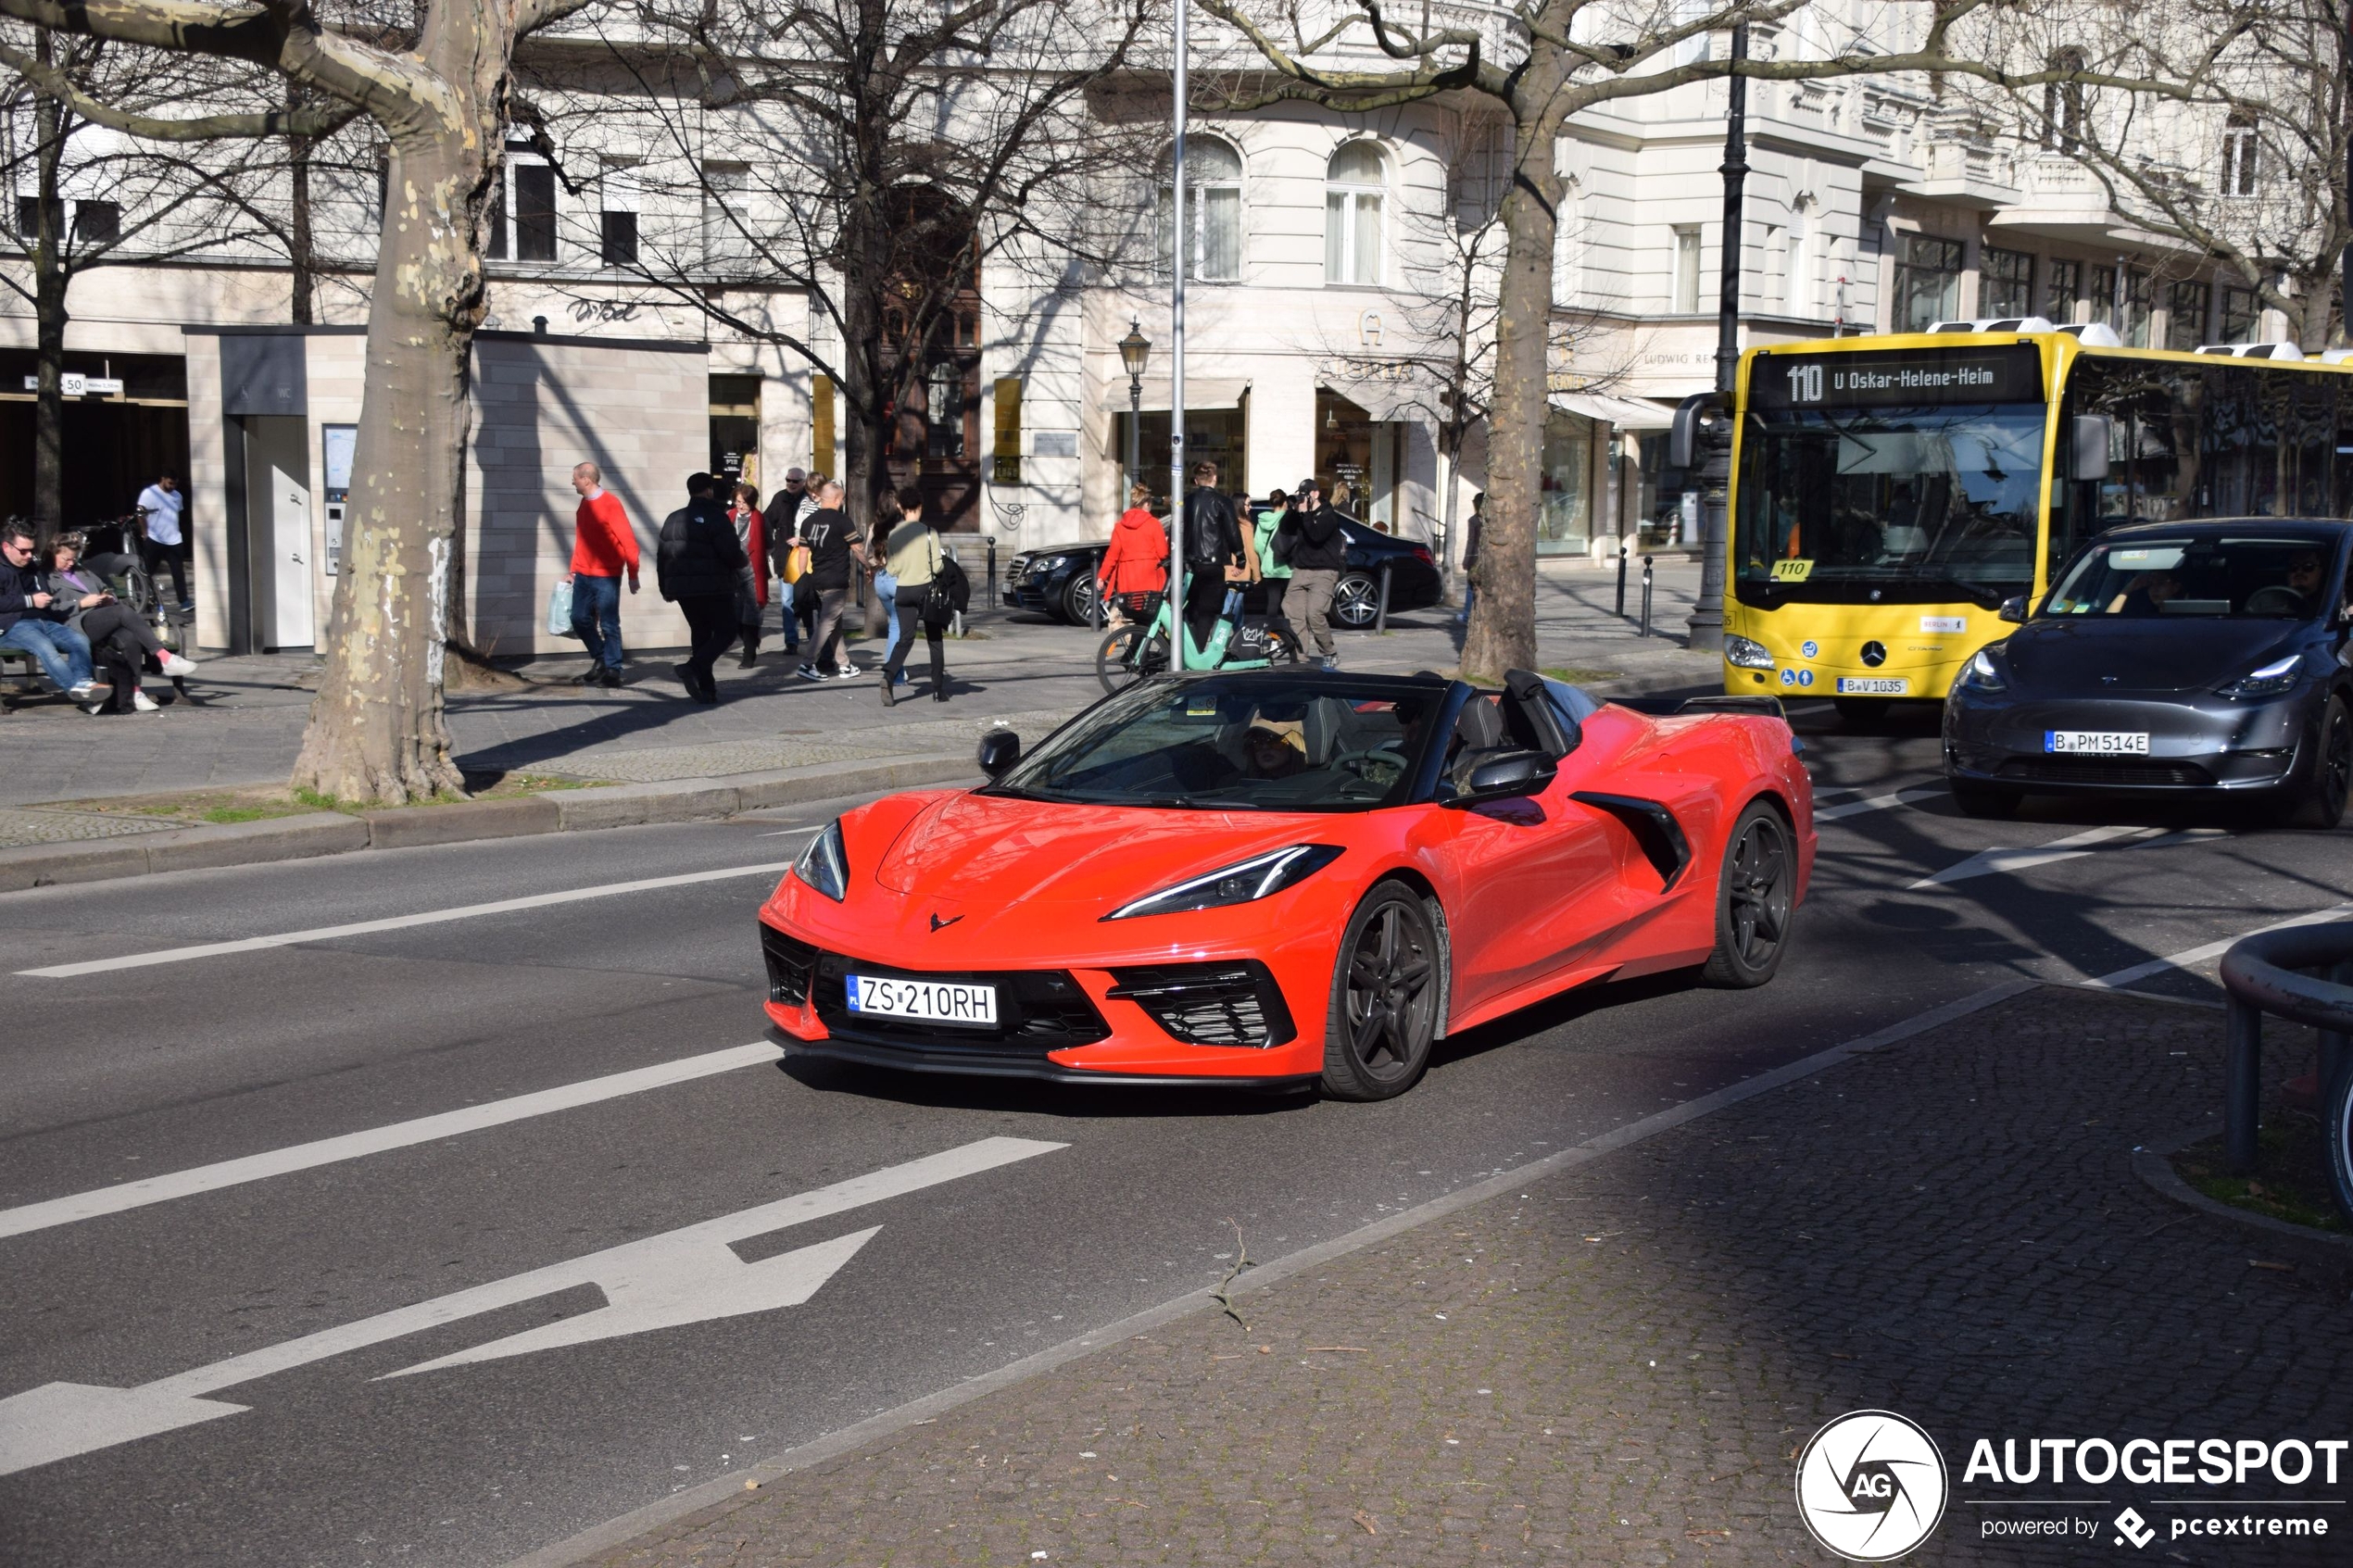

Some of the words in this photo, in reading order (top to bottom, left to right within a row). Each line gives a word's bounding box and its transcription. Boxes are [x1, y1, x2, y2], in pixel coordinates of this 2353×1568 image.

[1644, 354, 1688, 364] LUDWIG
[1787, 365, 1822, 402] 110
[1834, 372, 1843, 389] U
[1850, 367, 1994, 389] Oskar-Helene-Heim
[68, 380, 82, 390] 50
[279, 388, 291, 398] WC
[808, 524, 830, 548] 47
[1780, 562, 1806, 575] 110
[1872, 681, 1902, 693] 1035
[849, 997, 859, 1006] PL
